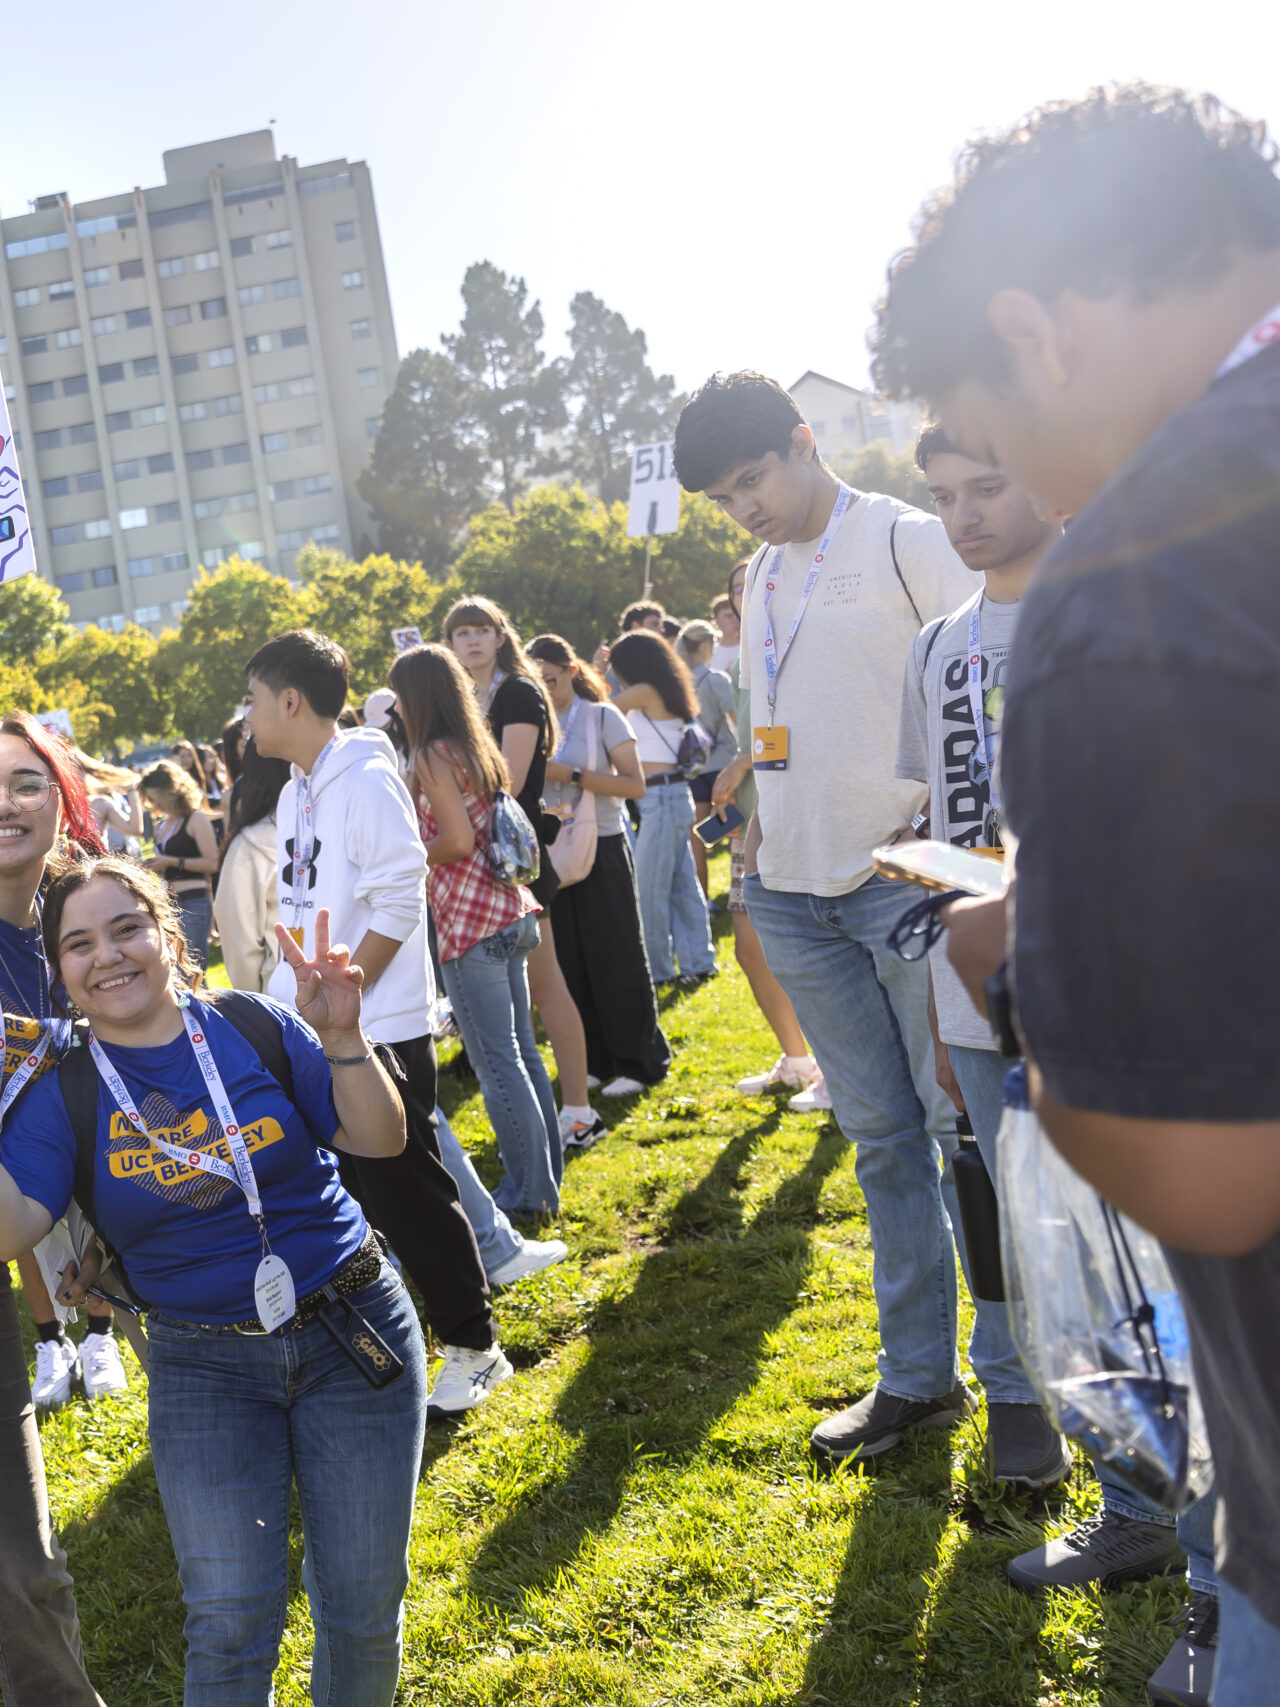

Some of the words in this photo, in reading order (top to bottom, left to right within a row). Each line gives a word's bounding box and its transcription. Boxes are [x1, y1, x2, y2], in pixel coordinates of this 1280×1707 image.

[969, 615, 978, 646] Berkeley
[942, 654, 989, 850] ADIDAS
[188, 1019, 198, 1034] BMO
[200, 1050, 216, 1081] Berkeley
[4, 1073, 27, 1105] Berkeley
[108, 1075, 128, 1105] Berkeley
[156, 1124, 194, 1148] ARE
[221, 1105, 232, 1124] BMO
[235, 1145, 252, 1184] Berkeley
[121, 1155, 149, 1172] UC
[168, 1148, 187, 1160] BMO
[360, 1338, 385, 1365] GBO
